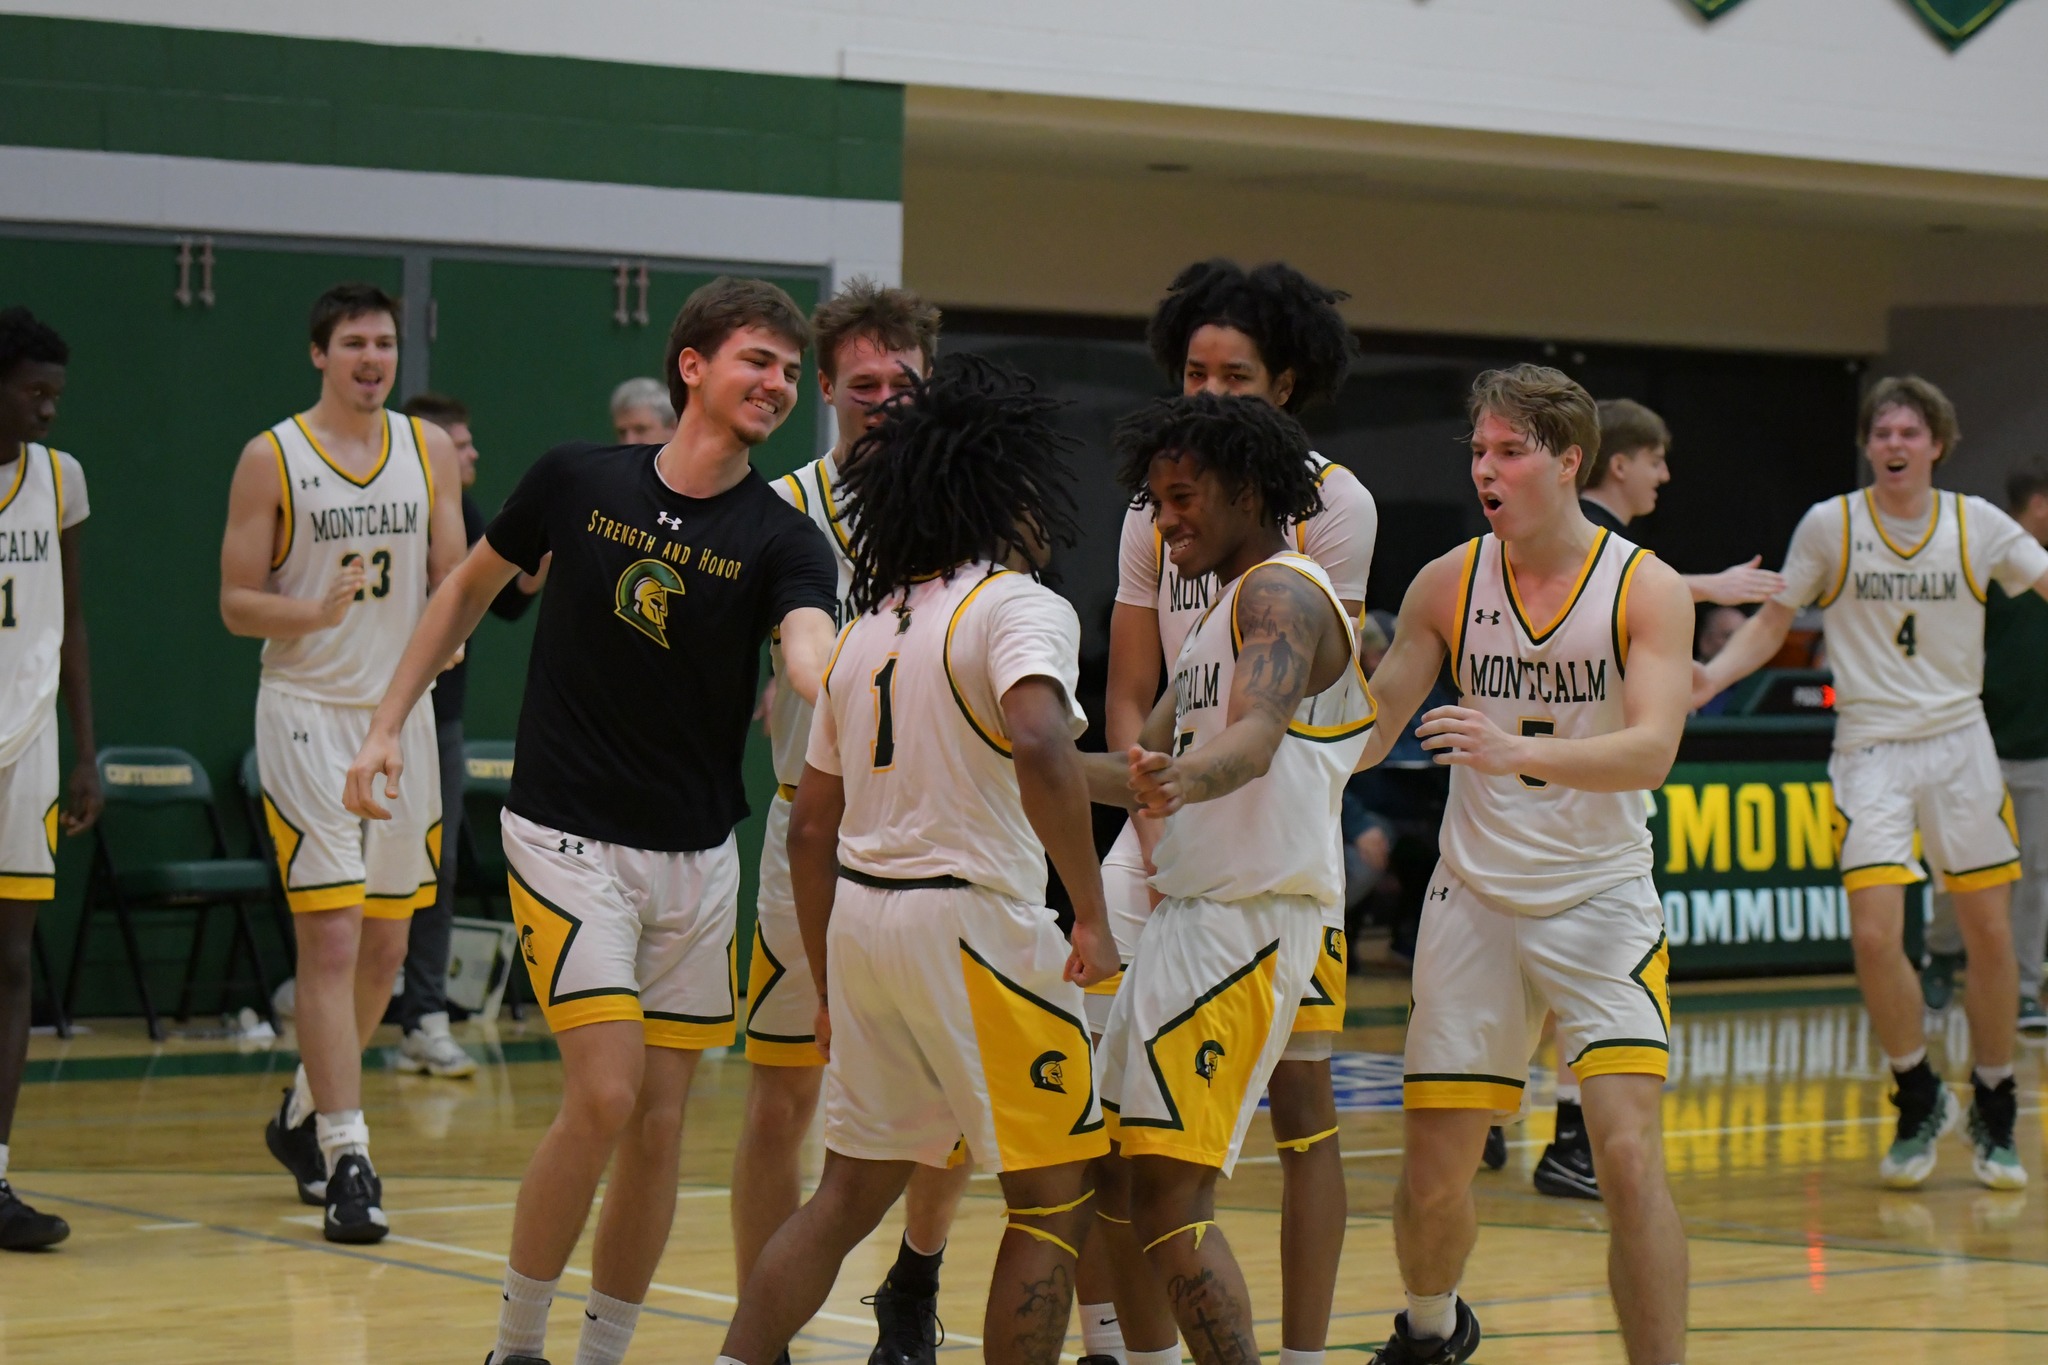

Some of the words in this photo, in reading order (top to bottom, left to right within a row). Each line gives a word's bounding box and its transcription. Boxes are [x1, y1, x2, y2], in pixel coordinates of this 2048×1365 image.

[310, 502, 418, 542] MONTCALM
[1855, 571, 1957, 600] MONTCALM
[1894, 610, 1918, 657] 4
[1470, 653, 1606, 704] MONTCALM
[871, 652, 898, 774] 1
[1662, 884, 1852, 947] OMMUNI
